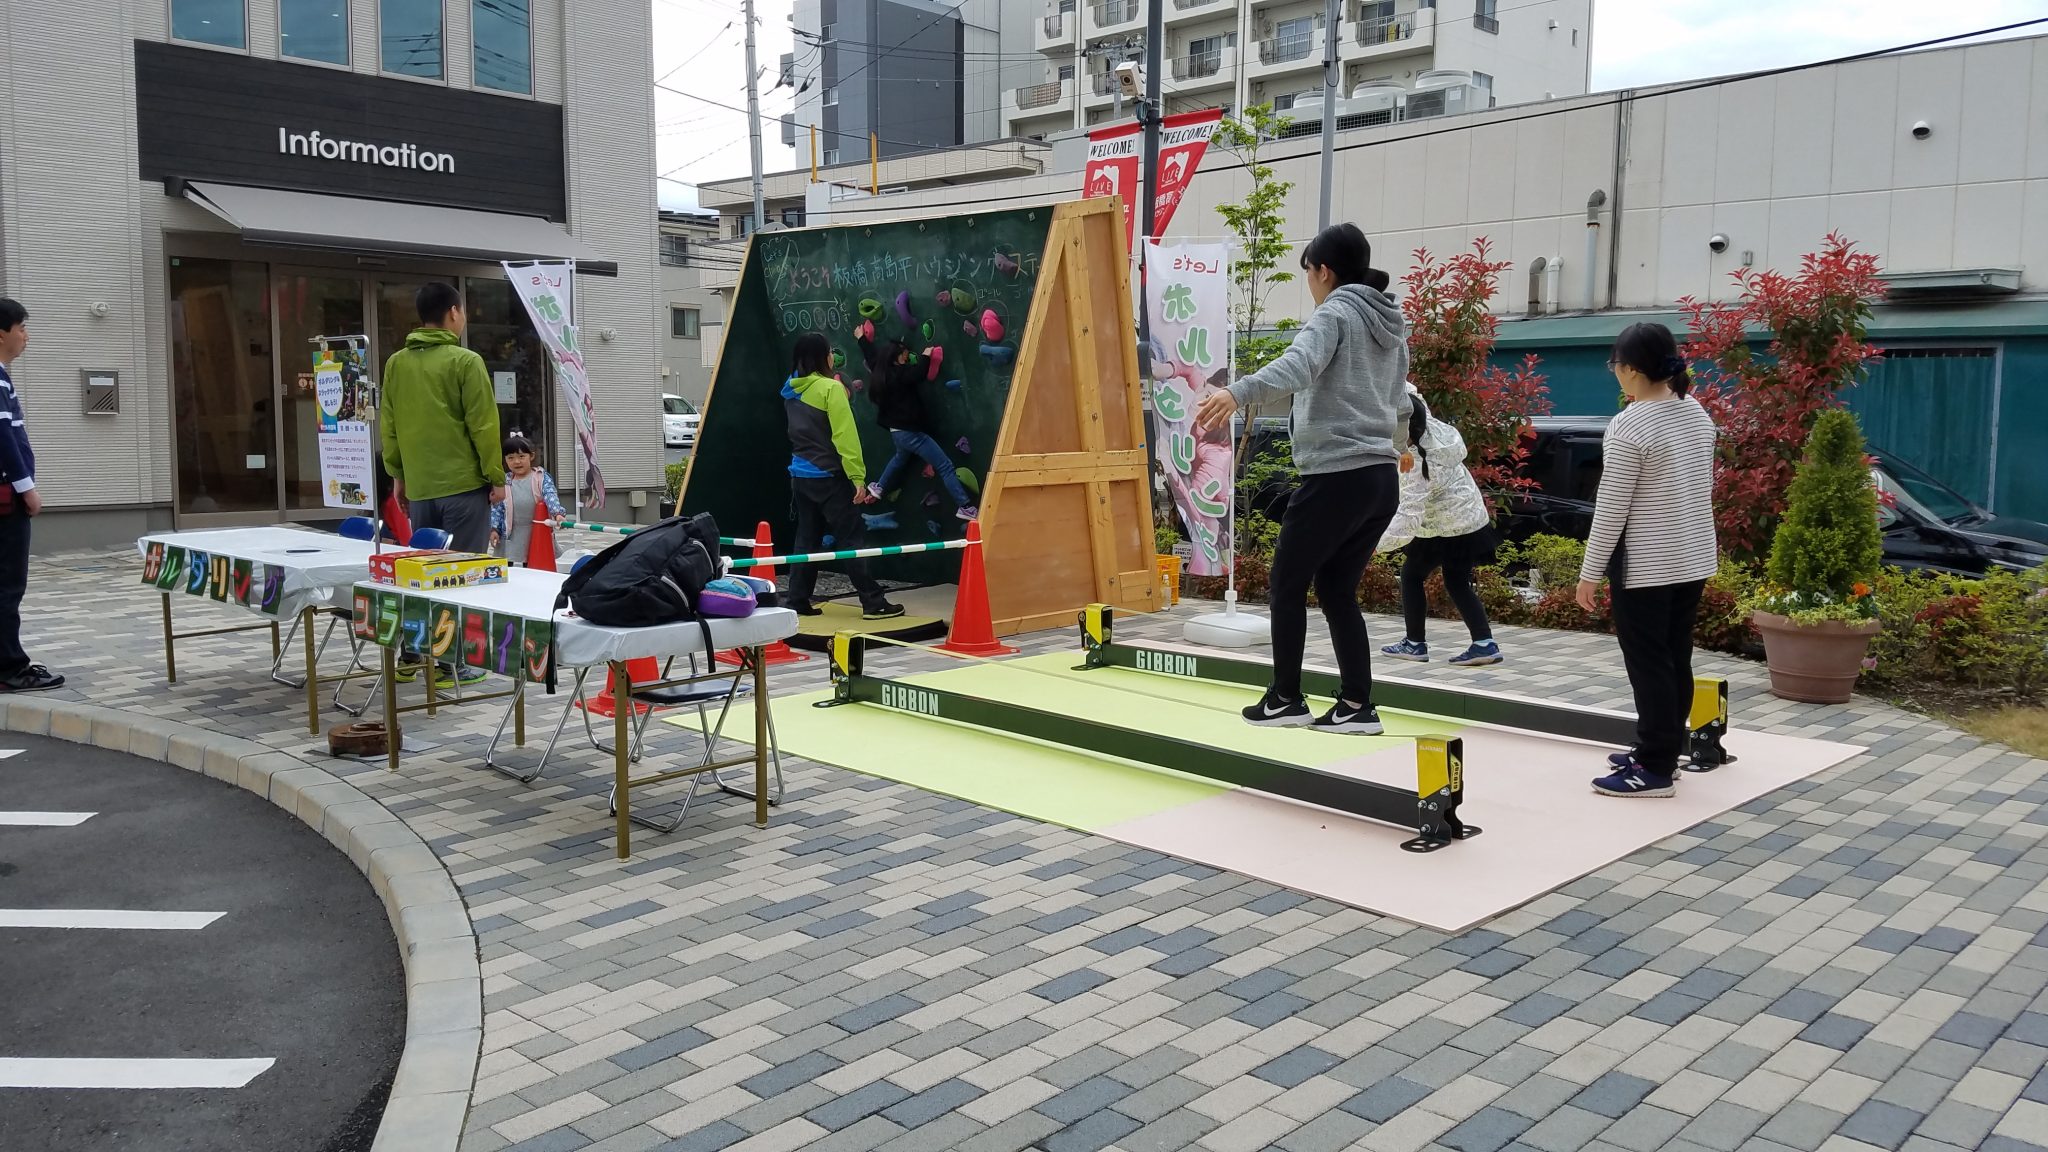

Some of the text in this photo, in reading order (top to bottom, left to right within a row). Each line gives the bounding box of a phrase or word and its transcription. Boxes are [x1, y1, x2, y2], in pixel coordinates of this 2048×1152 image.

[1162, 124, 1214, 146] WELCOME!
[278, 127, 455, 174] Information
[1090, 138, 1136, 158] WELCOME!
[1089, 181, 1112, 192] LIVE
[1161, 166, 1180, 183] LIVE
[145, 543, 286, 607] ボルダリング
[1136, 649, 1198, 677] GIBBON
[881, 683, 940, 717] GIBBON
